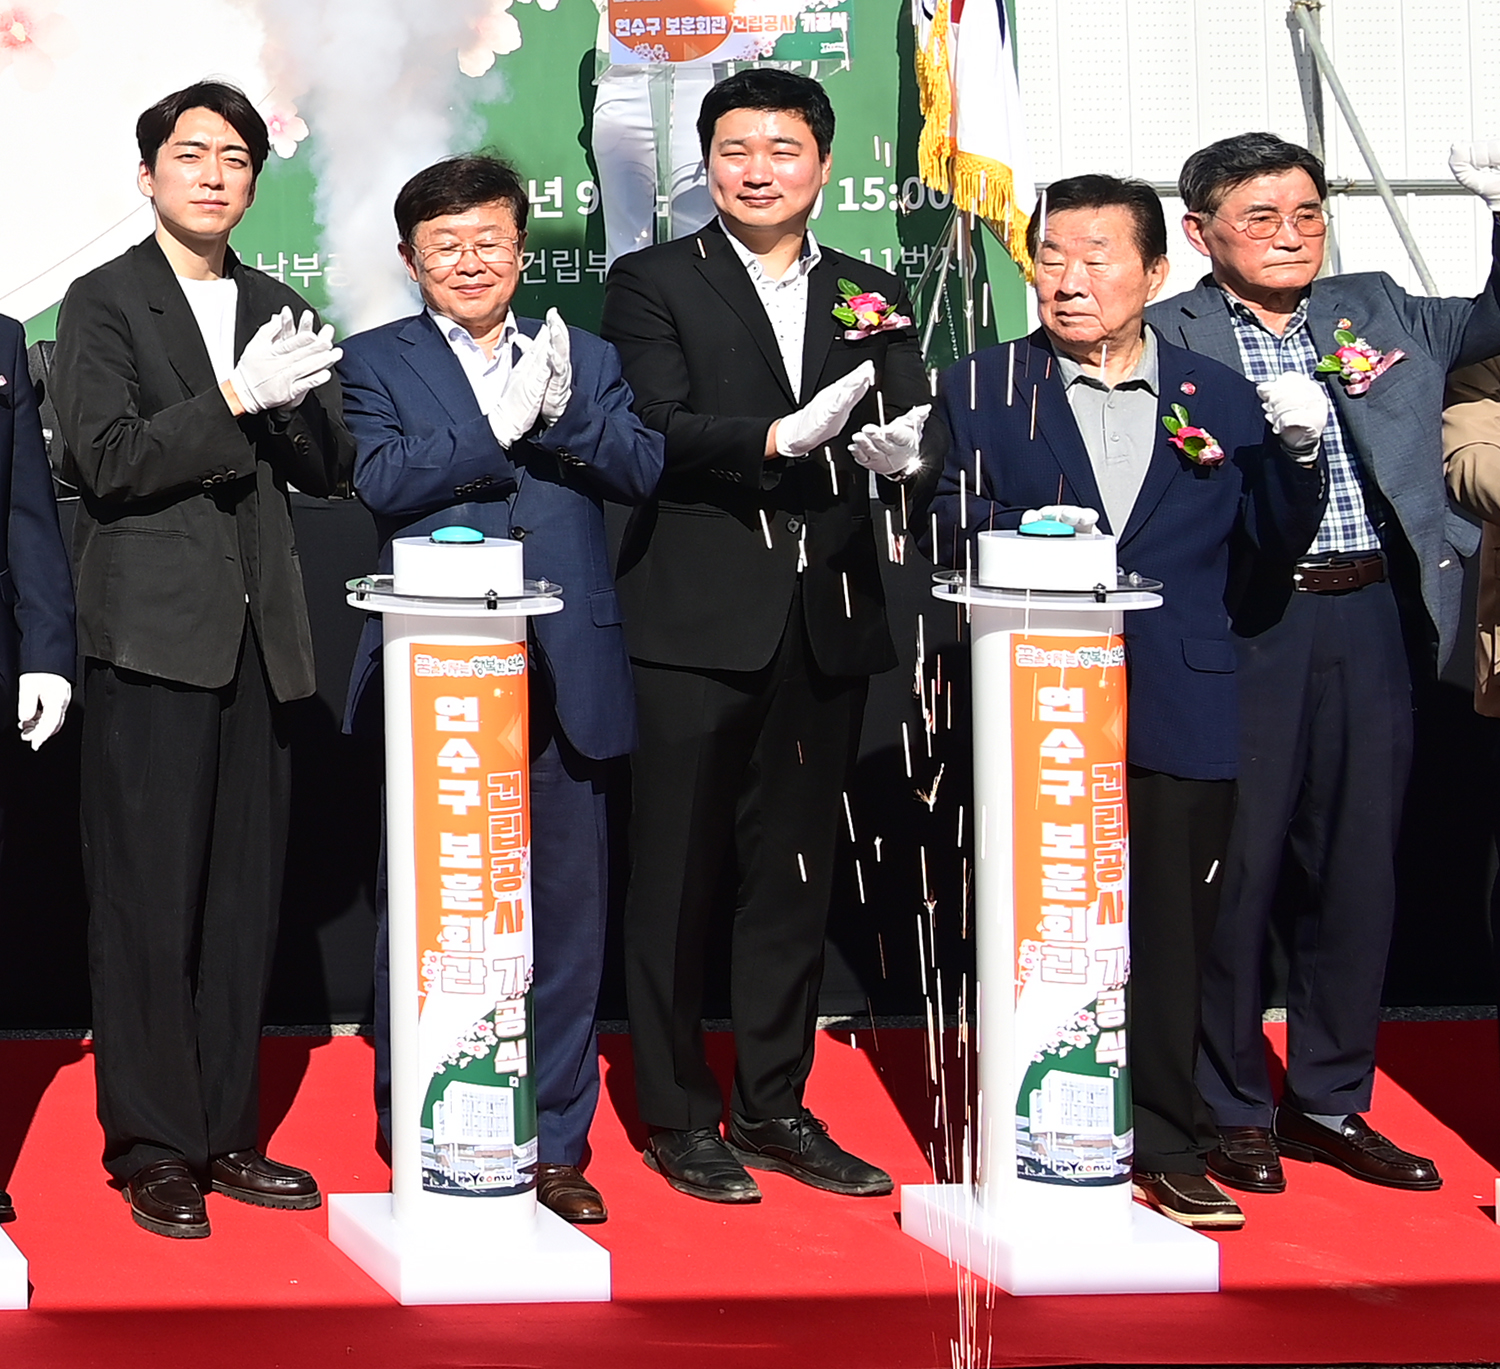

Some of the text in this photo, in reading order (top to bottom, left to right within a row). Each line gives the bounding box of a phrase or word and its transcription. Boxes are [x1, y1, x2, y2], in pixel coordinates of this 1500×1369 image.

[615, 17, 661, 36] 연수구
[666, 16, 727, 36] 보훈회관
[732, 14, 795, 33] 건립공사
[434, 696, 485, 996] 연수구 보훈회관
[488, 771, 528, 1079] 건립공사 기공식
[1037, 686, 1088, 986] 연수구 보훈회관
[1091, 761, 1128, 1070] 건립공사 기공식
